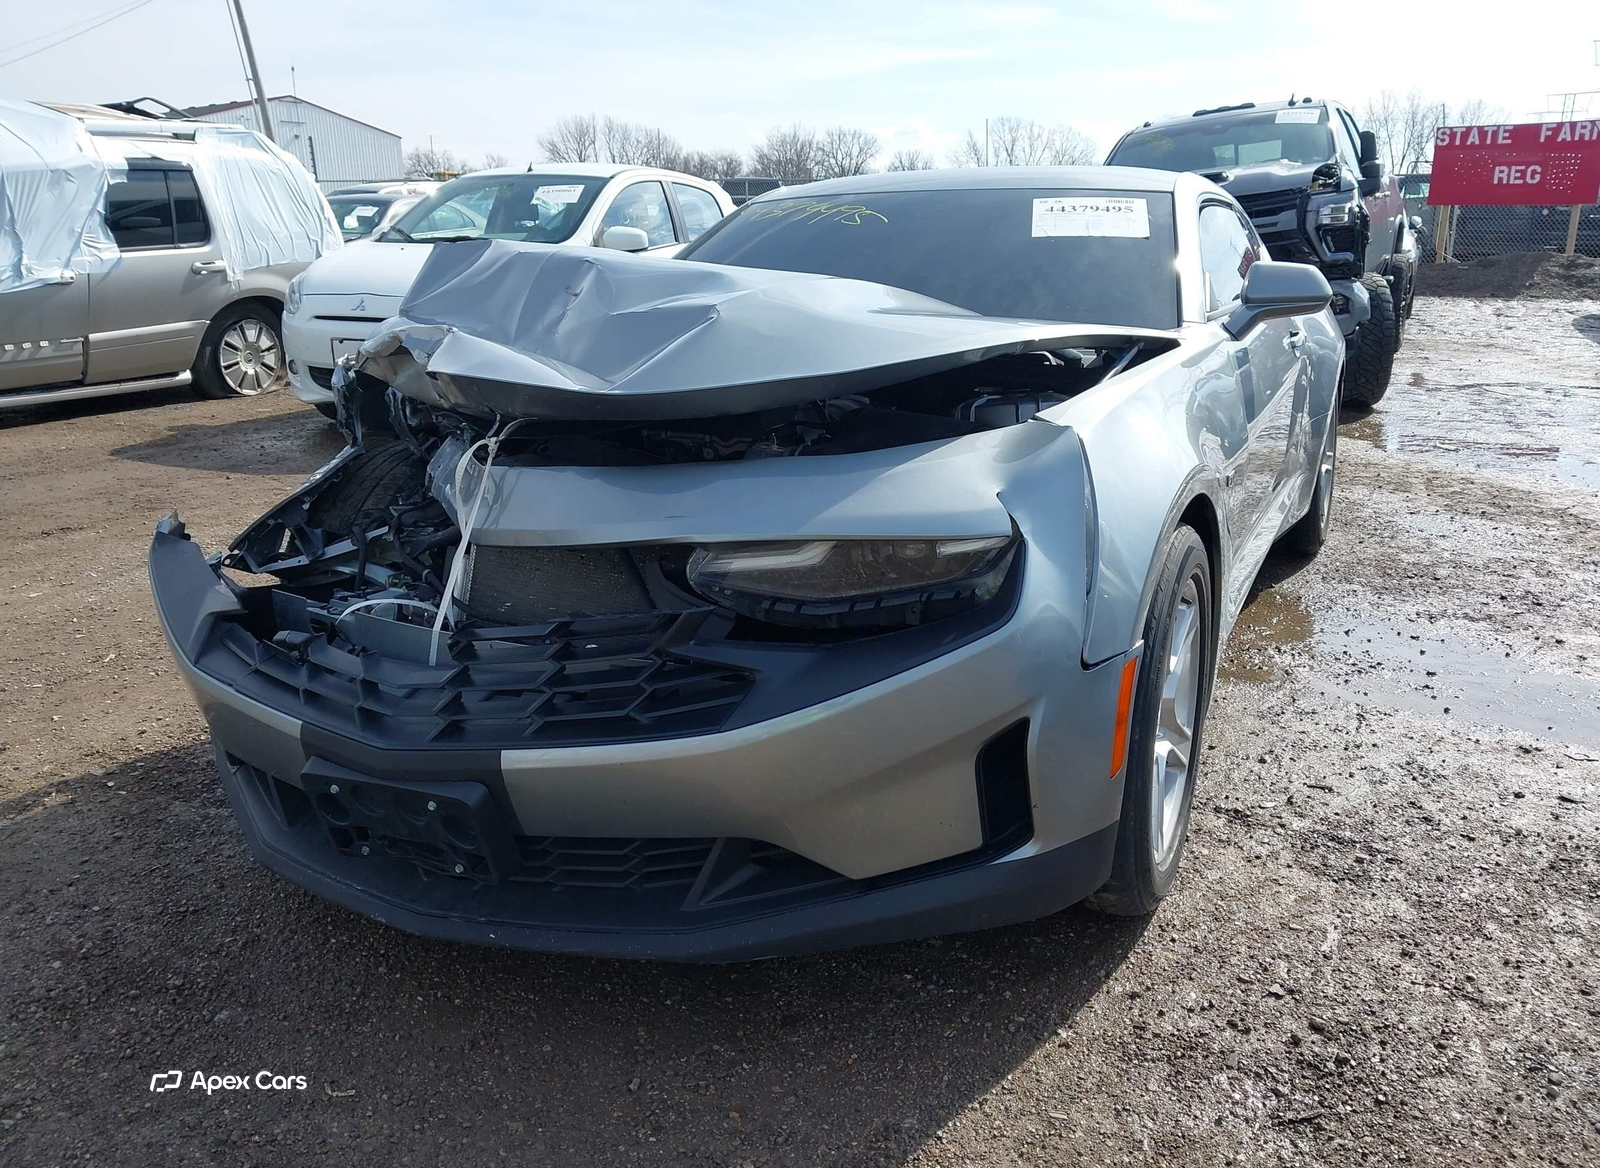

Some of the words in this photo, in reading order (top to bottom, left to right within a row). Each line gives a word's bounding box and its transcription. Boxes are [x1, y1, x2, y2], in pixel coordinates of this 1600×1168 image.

[1436, 125, 1514, 146] STATE
[1493, 165, 1542, 185] REG
[1045, 205, 1134, 214] 44379495
